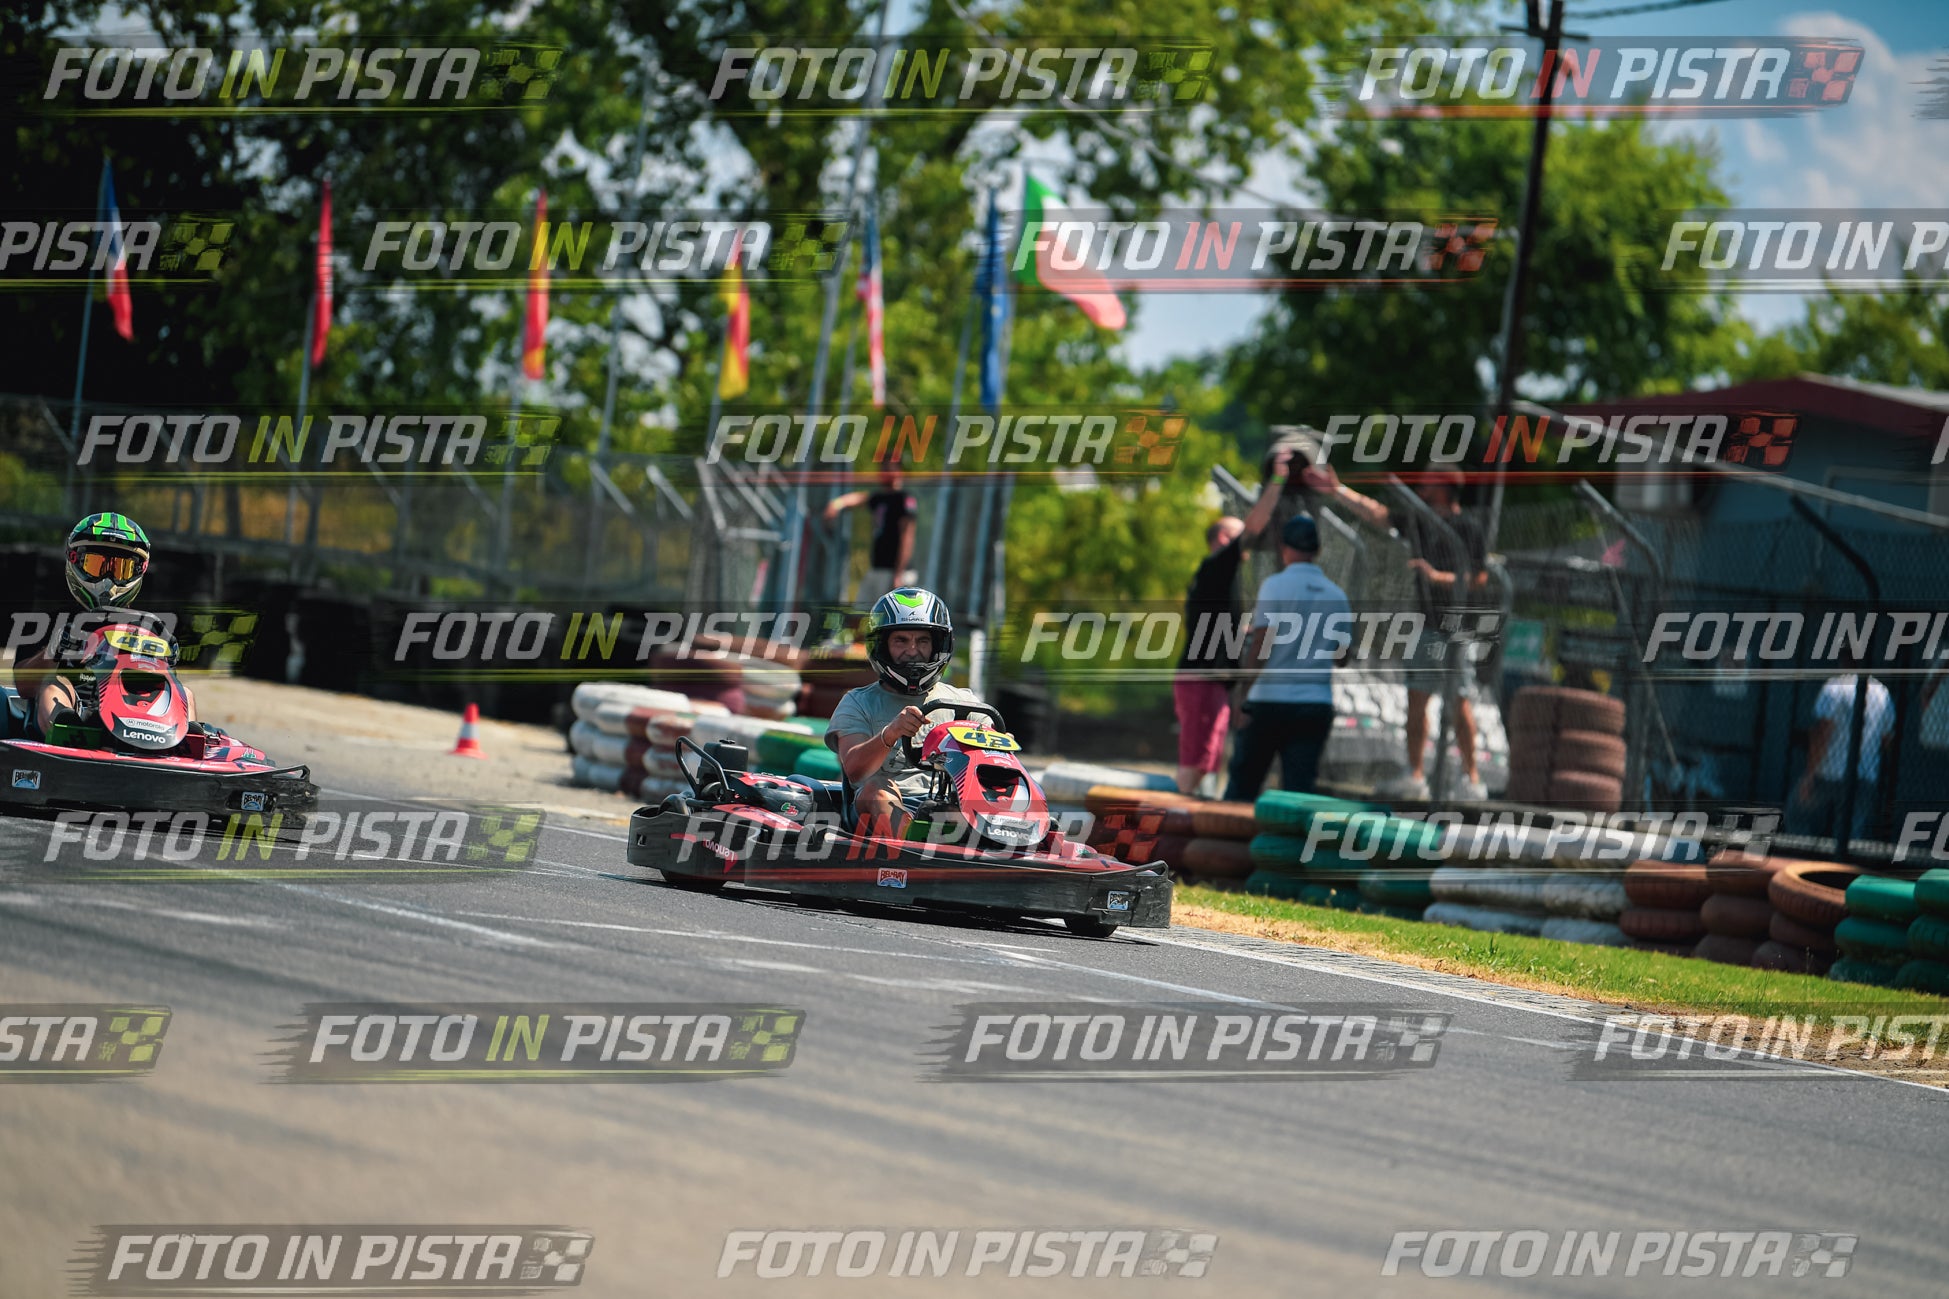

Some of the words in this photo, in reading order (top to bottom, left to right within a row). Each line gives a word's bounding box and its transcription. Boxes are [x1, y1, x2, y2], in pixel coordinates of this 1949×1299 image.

[116, 635, 164, 654] 46
[136, 720, 165, 731] motorola
[123, 729, 166, 744] Lenovo
[964, 732, 1012, 748] 43
[987, 827, 1029, 840] Lenovo
[705, 839, 735, 863] Lenovo
